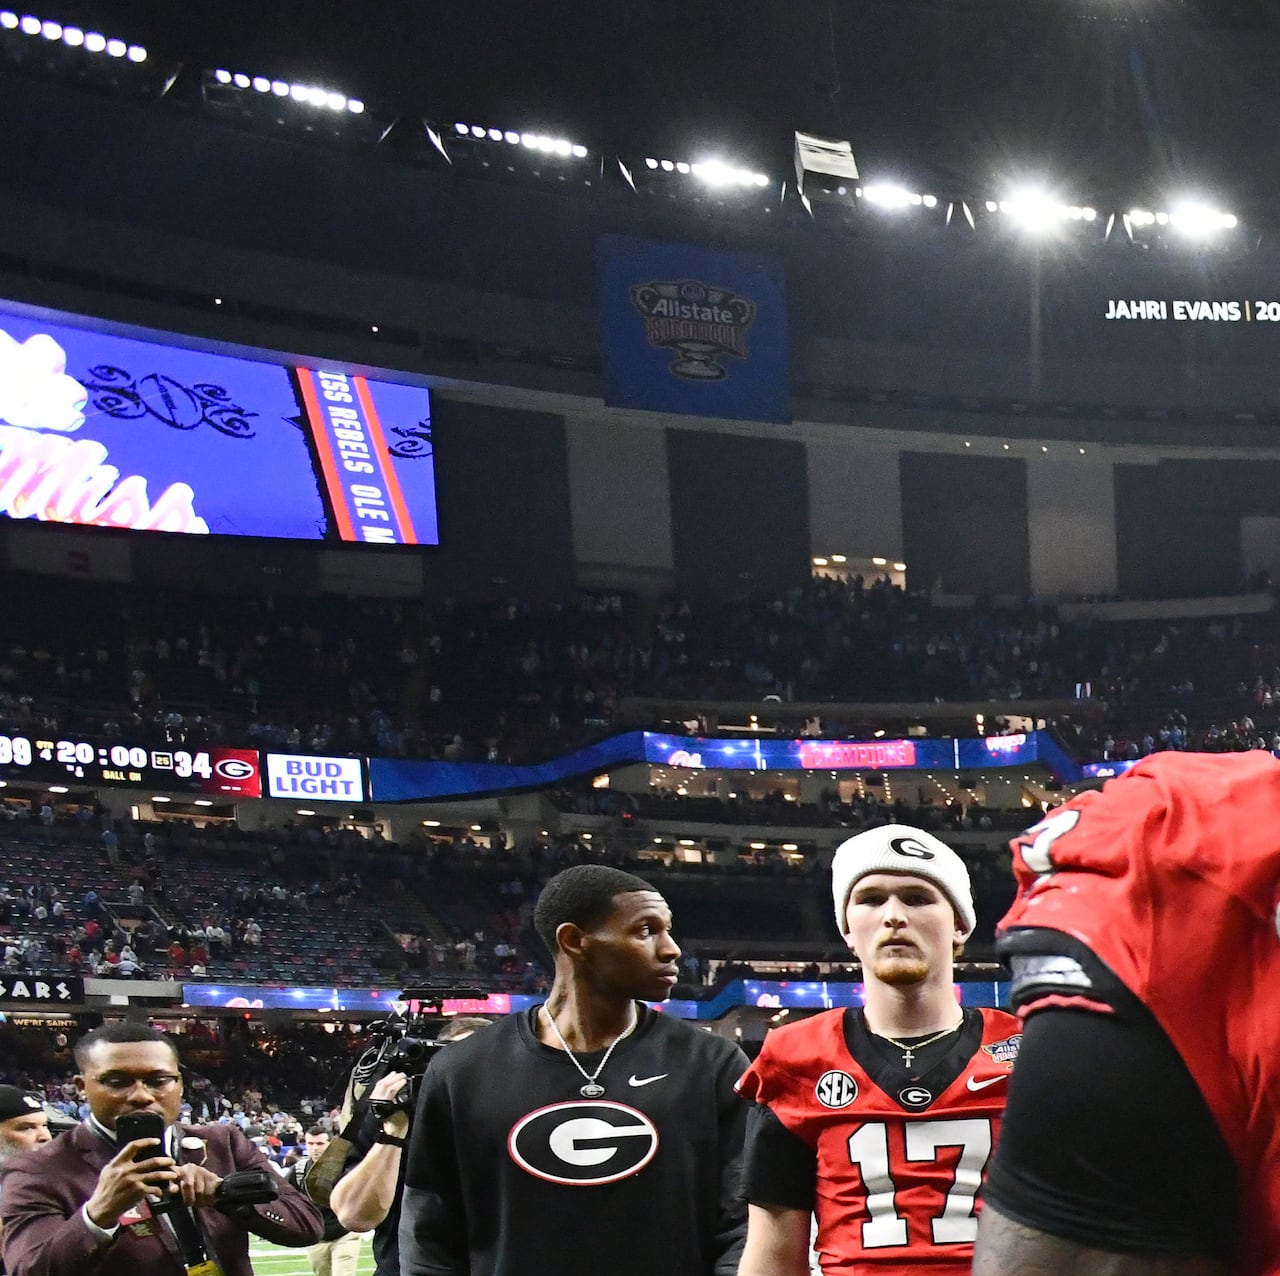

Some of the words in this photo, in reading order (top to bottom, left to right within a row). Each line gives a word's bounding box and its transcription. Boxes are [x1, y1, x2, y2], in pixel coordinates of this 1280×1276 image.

[652, 299, 733, 323] Allstate
[1104, 301, 1167, 320] JAHRI
[1172, 301, 1241, 321] EVANS
[328, 406, 374, 474] REBELS
[351, 484, 389, 522] OLE
[174, 751, 213, 778] 34
[286, 761, 341, 778] BUD
[276, 776, 354, 795] LIGHT
[819, 1072, 855, 1107] SEC
[848, 1117, 993, 1249] 17
